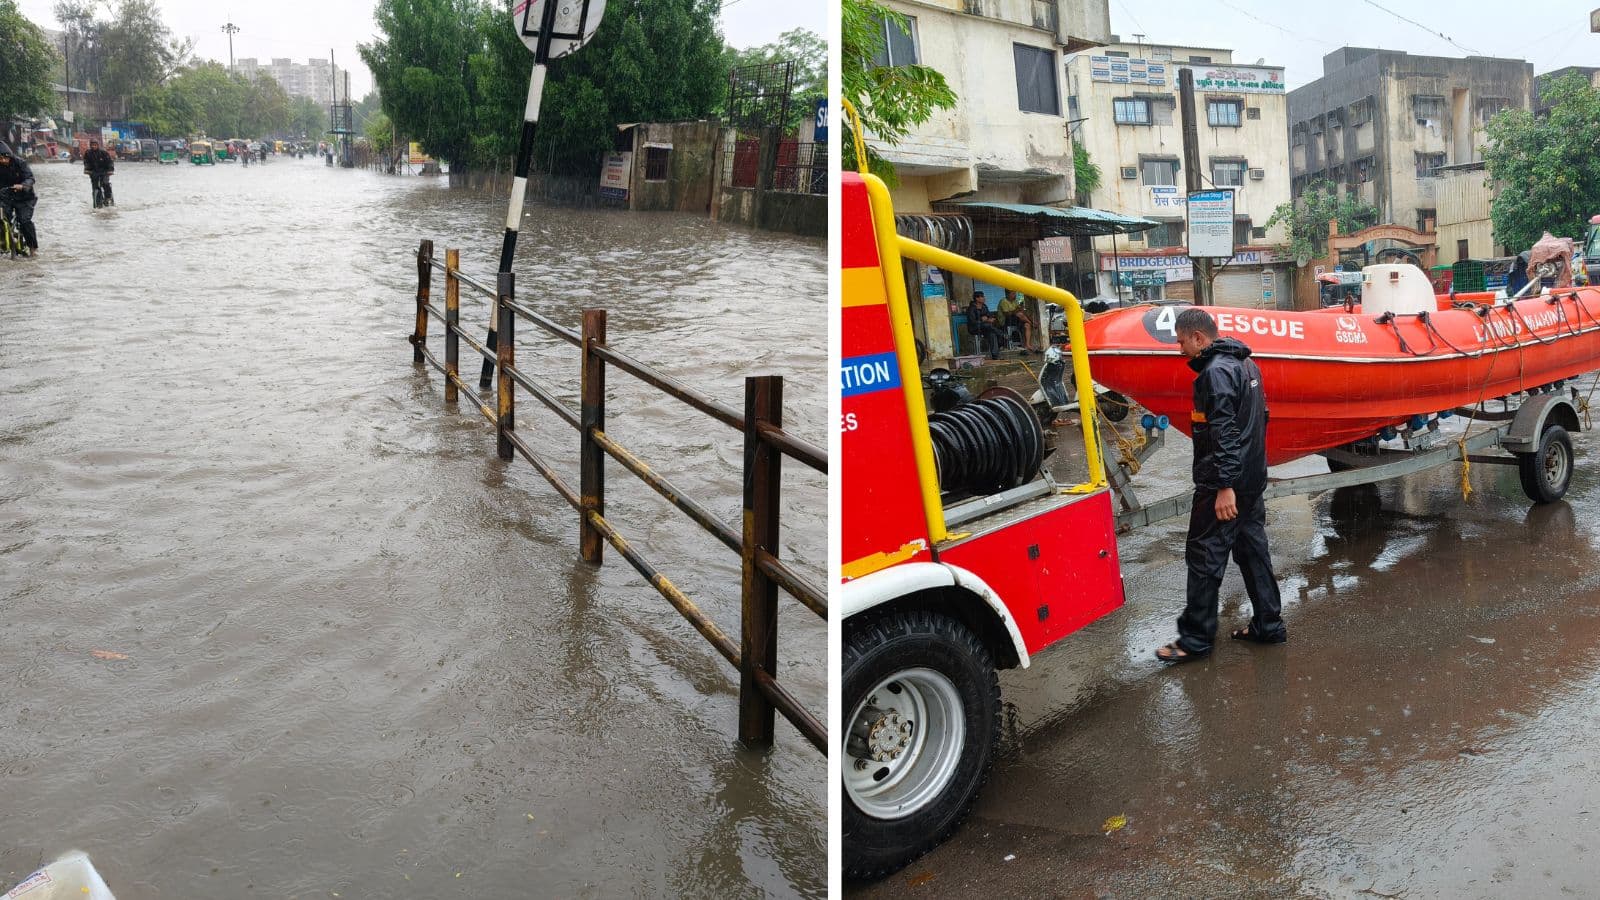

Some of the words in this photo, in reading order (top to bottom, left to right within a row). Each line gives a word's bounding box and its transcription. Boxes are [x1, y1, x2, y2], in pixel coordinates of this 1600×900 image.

[1155, 305, 1177, 337] 4
[1212, 313, 1305, 340] ESCUE
[841, 360, 890, 389] TION
